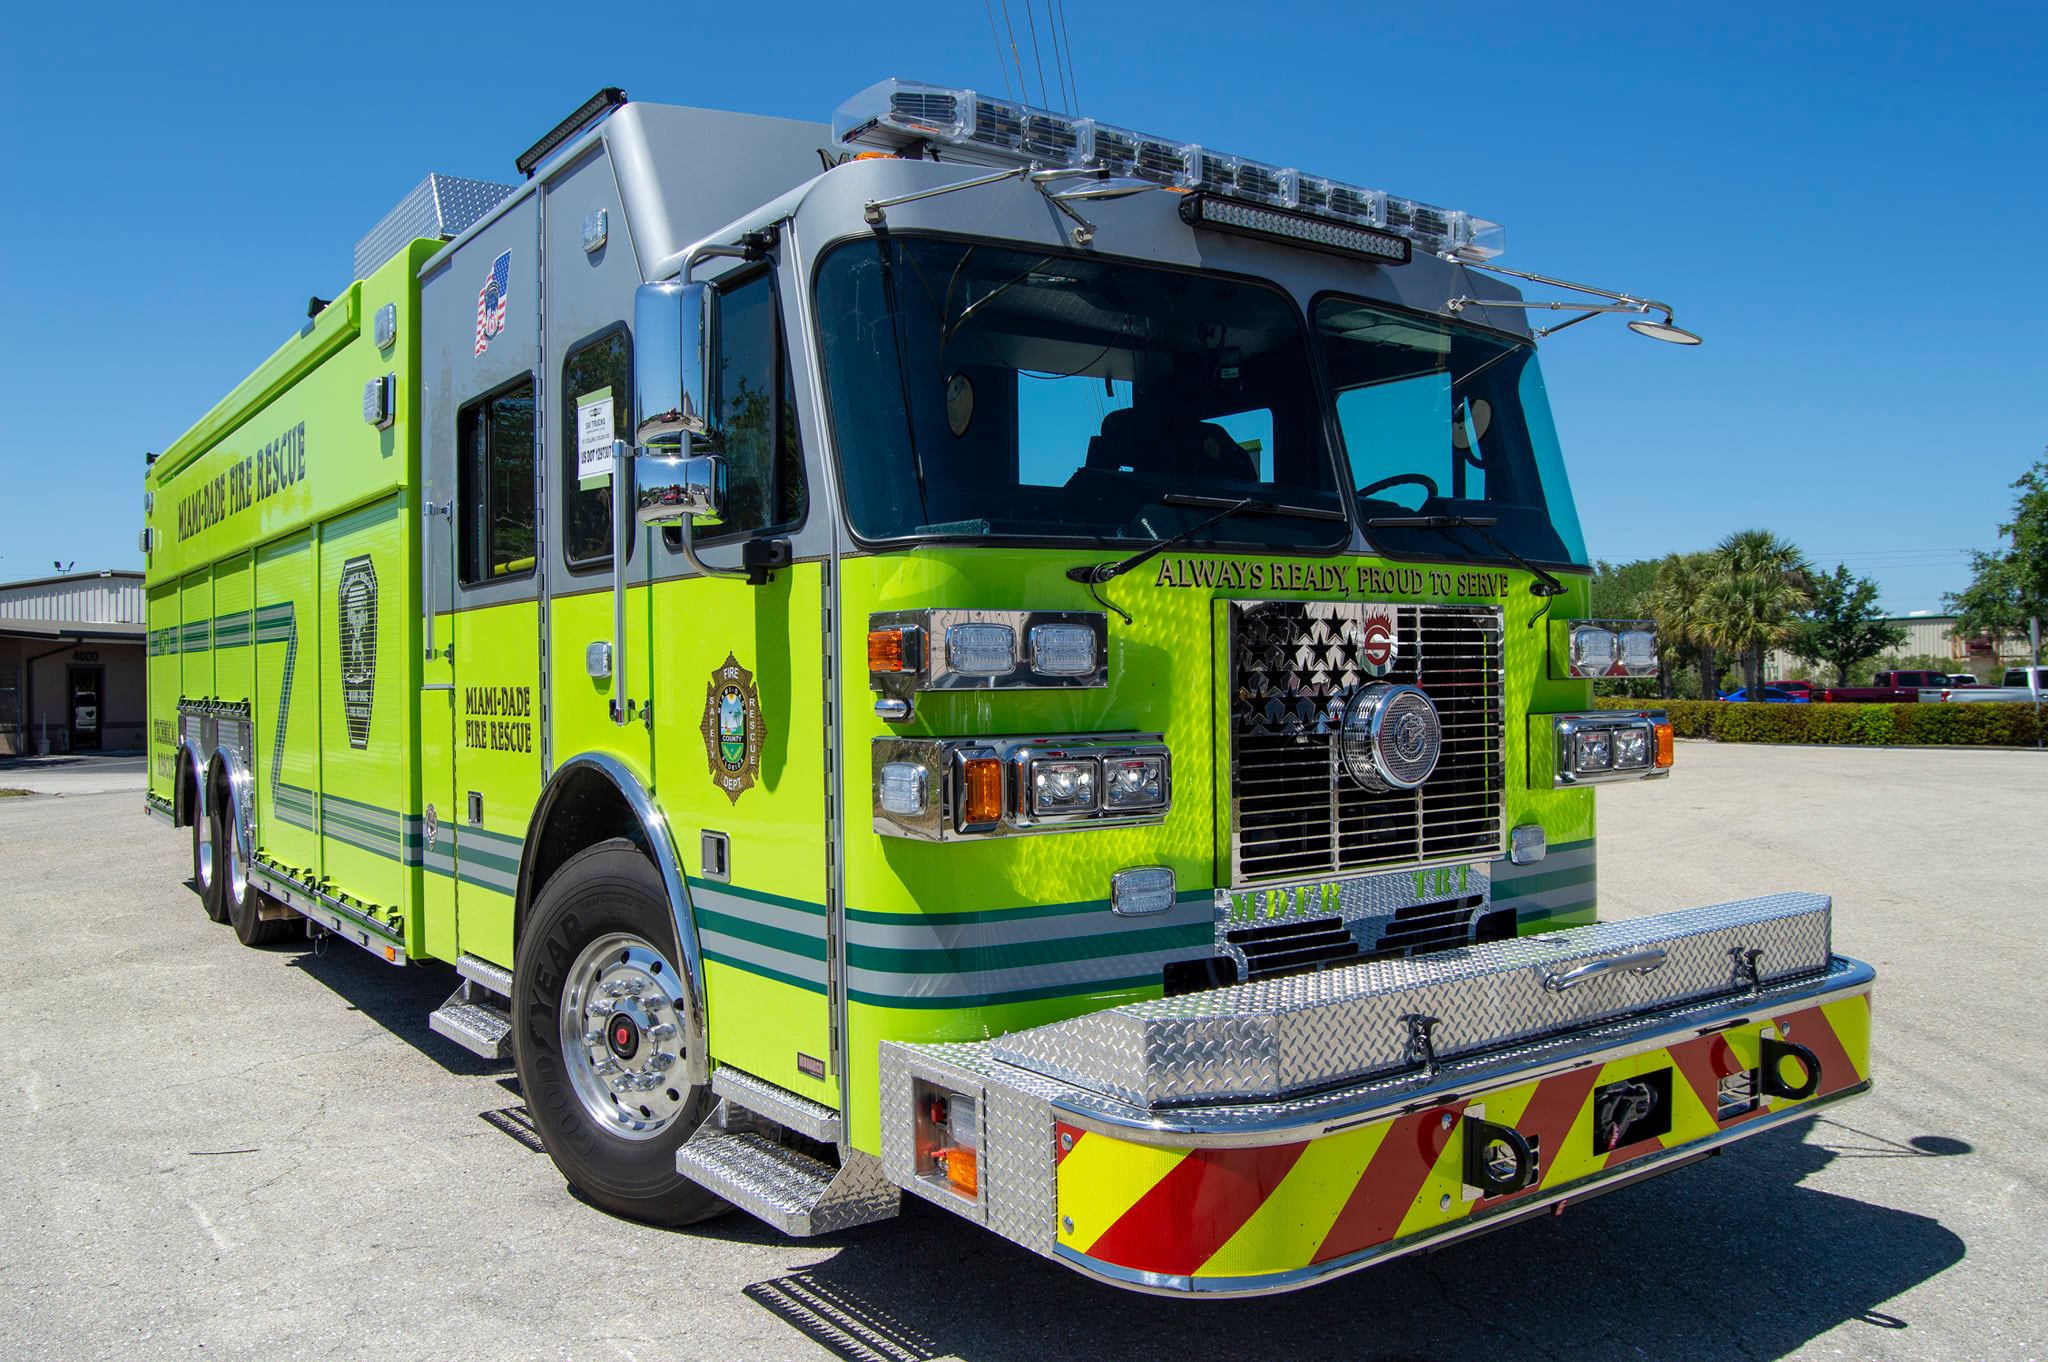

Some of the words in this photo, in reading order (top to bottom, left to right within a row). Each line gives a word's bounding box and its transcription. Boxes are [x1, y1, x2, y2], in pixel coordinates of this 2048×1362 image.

[230, 456, 252, 516] FIRE
[257, 421, 305, 502] RESCUE
[1155, 559, 1264, 589] ALWAYS
[1270, 563, 1350, 597] READY,
[1358, 567, 1424, 594] PROUD
[1430, 570, 1452, 596] TO
[1457, 573, 1509, 598] SERVE
[723, 666, 740, 680] FIRE
[466, 720, 487, 749] FIRE
[491, 721, 531, 753] RESCUE
